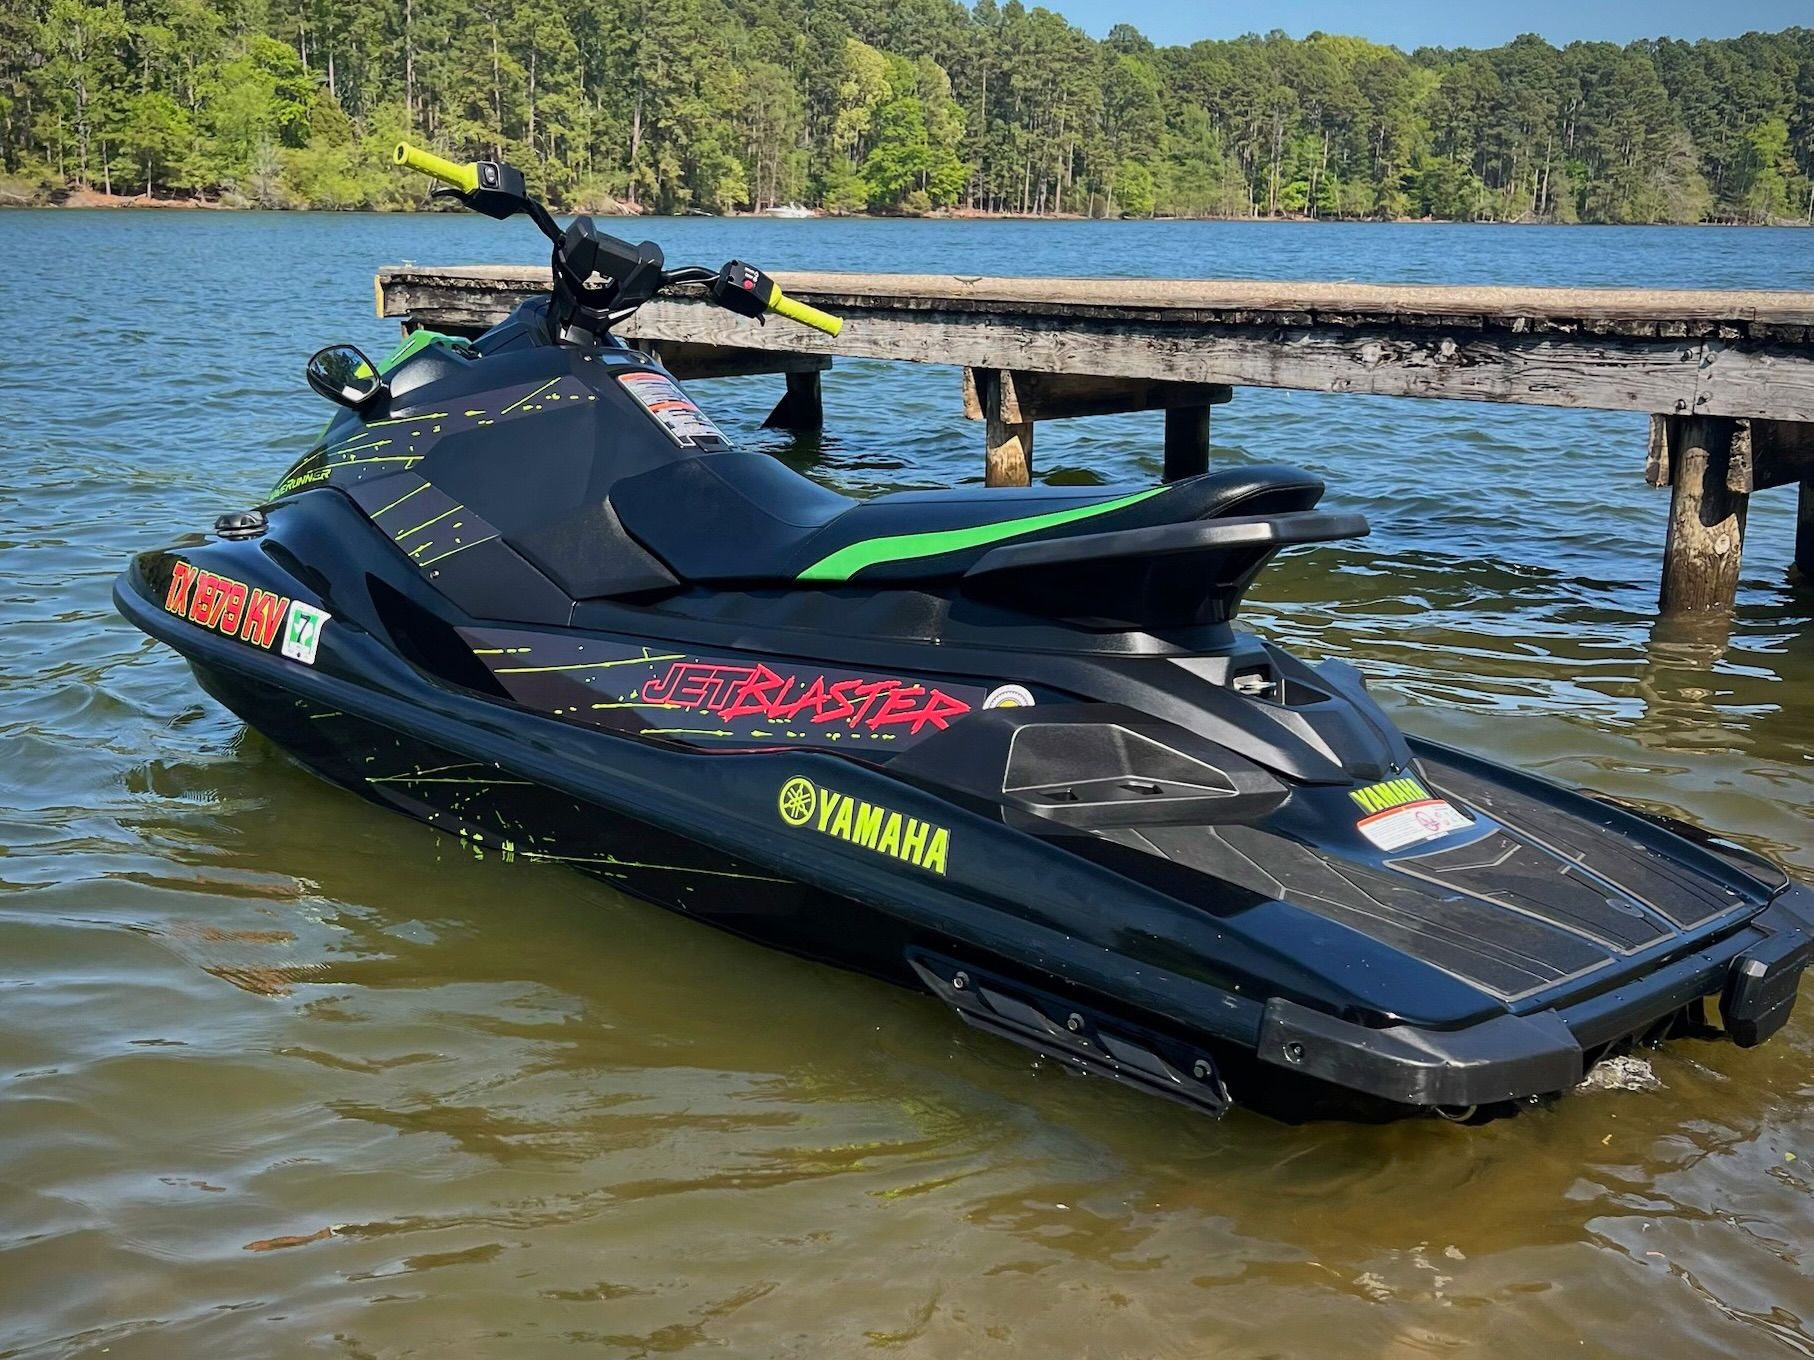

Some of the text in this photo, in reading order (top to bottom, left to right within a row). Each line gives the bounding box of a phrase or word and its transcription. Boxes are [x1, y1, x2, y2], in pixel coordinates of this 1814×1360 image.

[165, 561, 197, 616] TX
[241, 588, 290, 649] KV
[296, 614, 311, 643] 7
[1350, 778, 1432, 813] YAMAHA
[817, 789, 952, 875] YAMAHA
